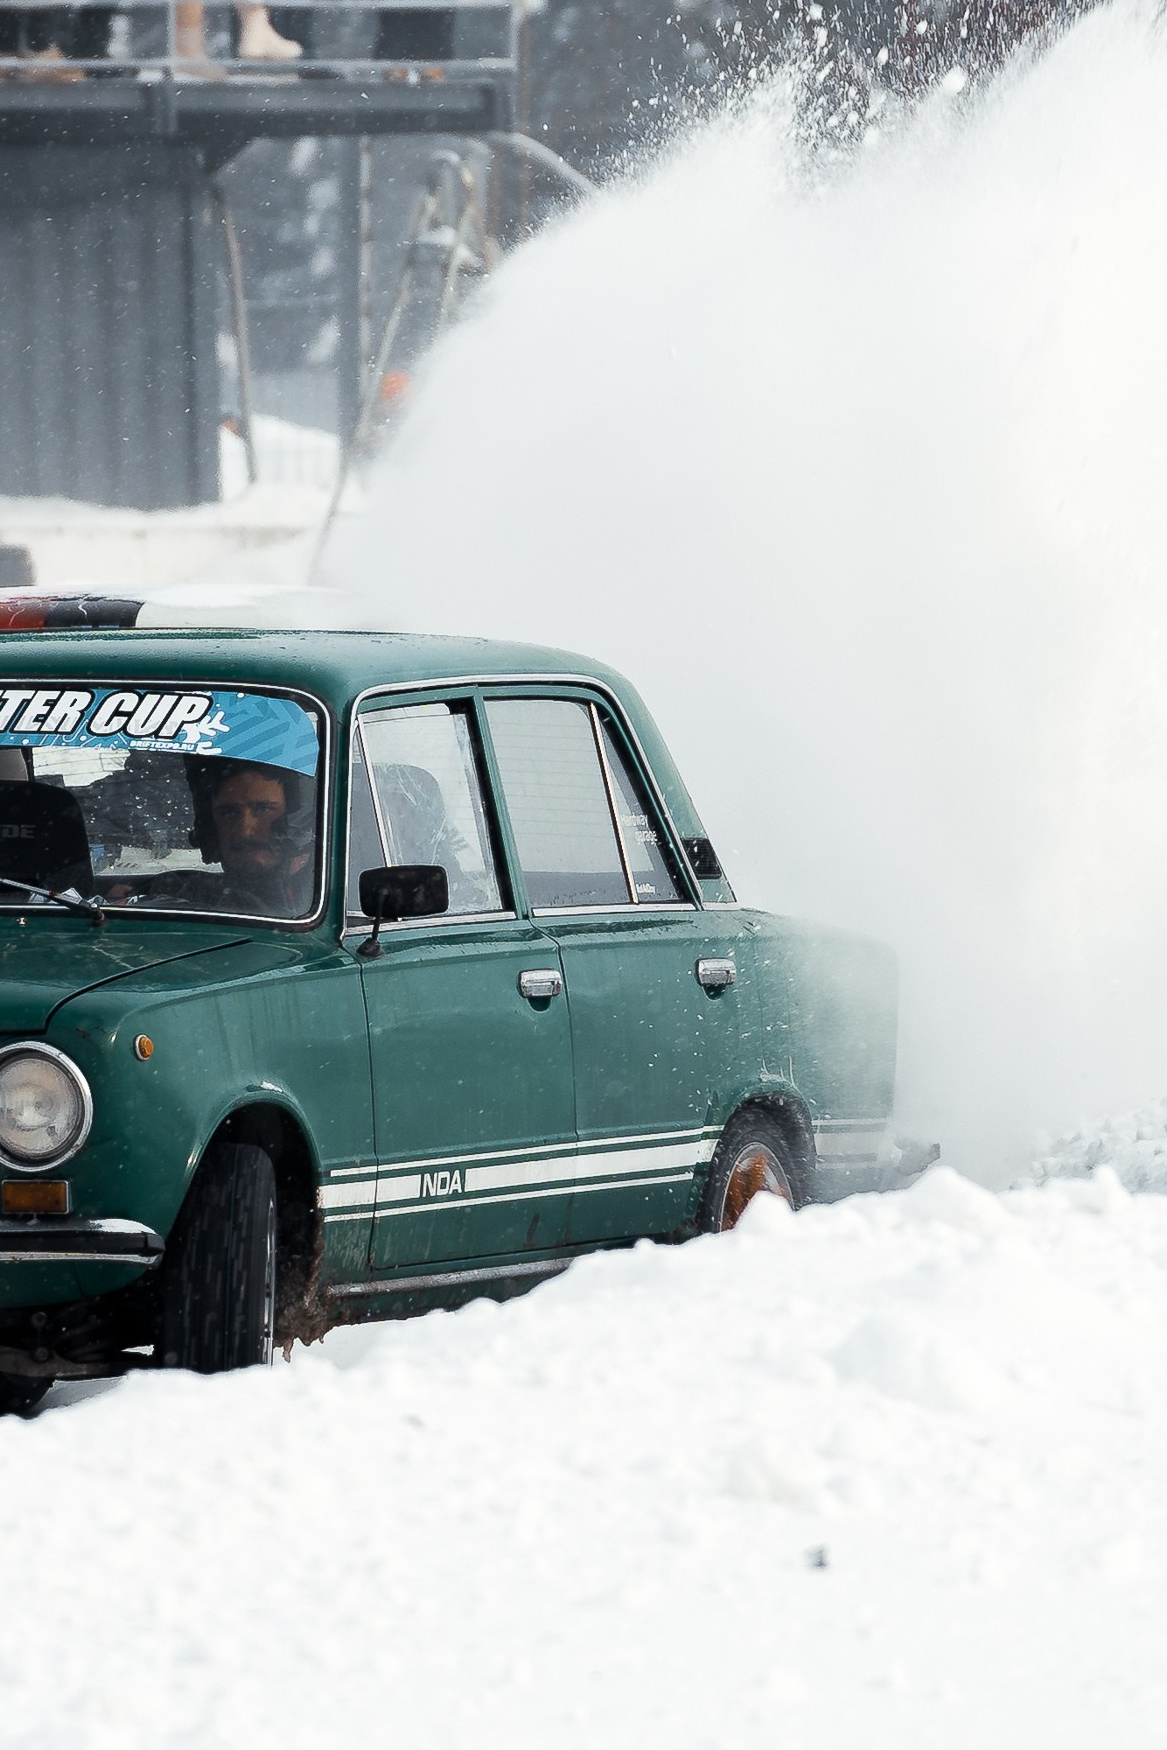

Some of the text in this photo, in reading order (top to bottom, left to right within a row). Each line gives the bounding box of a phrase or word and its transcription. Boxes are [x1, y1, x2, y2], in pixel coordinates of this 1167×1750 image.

[91, 692, 211, 738] CUP
[129, 740, 195, 751] DRIFTEXPO.RU
[422, 1169, 463, 1198] NDA
